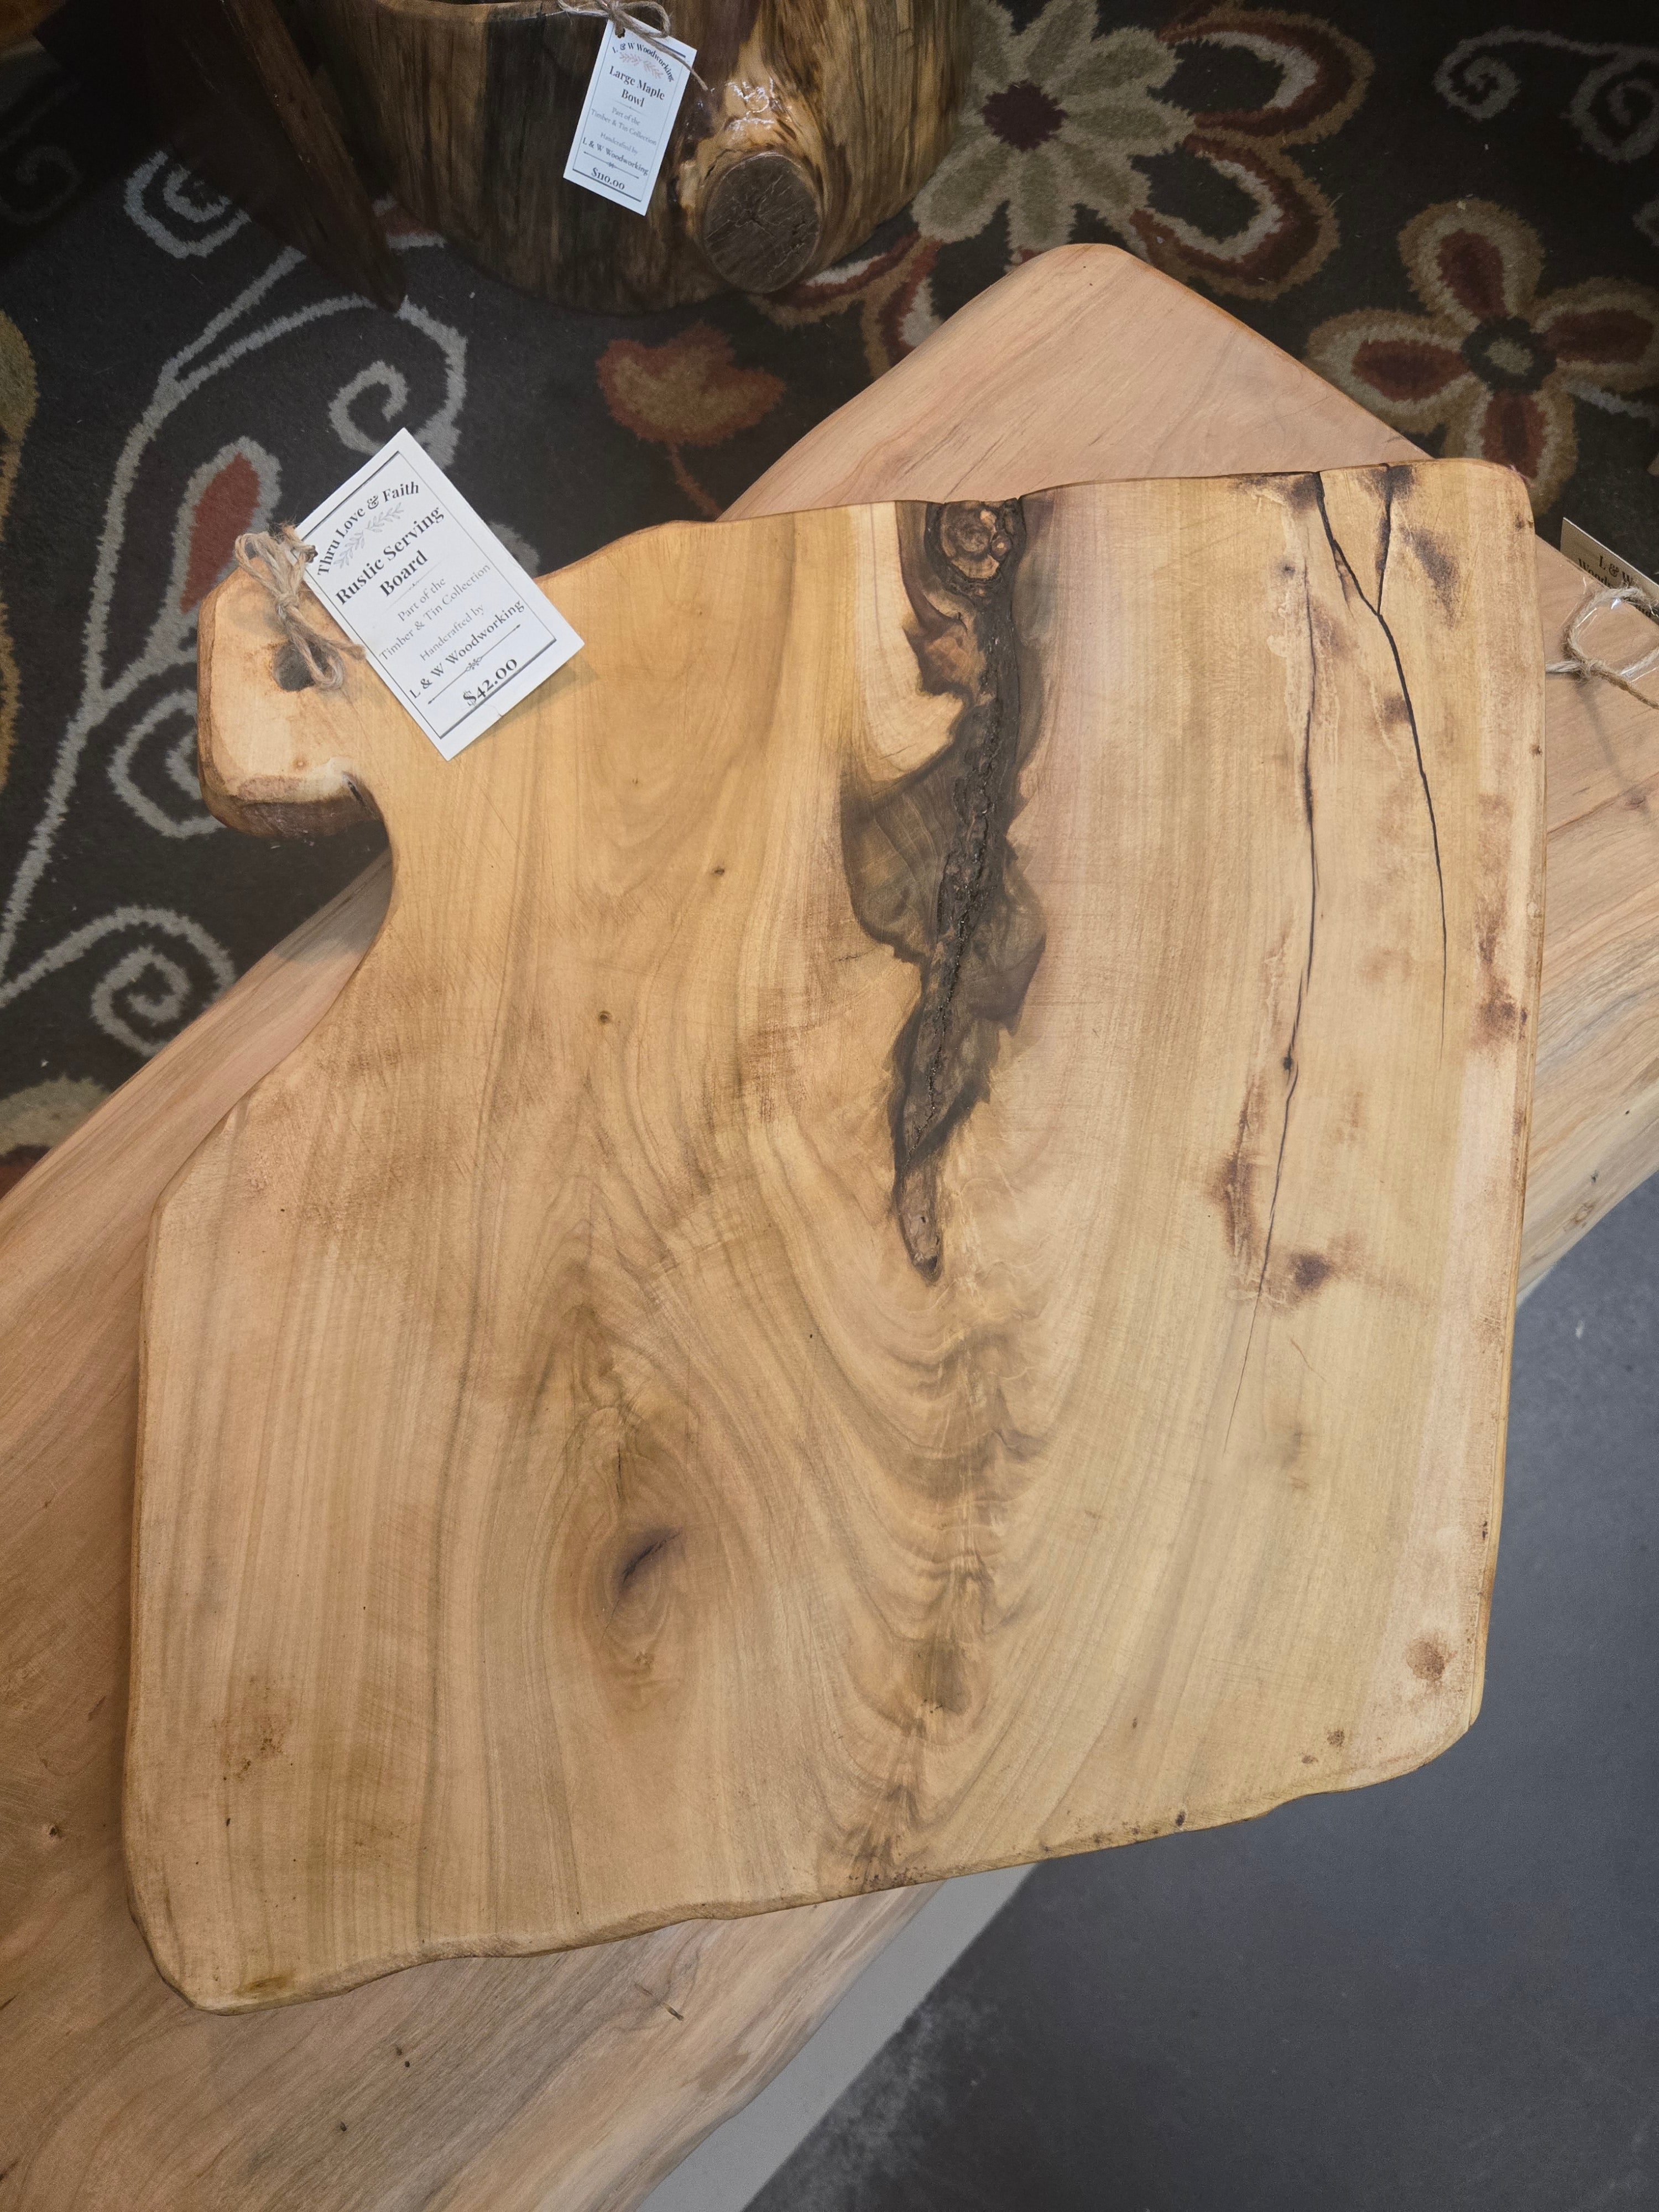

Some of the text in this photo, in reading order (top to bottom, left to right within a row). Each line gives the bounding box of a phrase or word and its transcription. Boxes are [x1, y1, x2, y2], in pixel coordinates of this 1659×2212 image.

[609, 66, 665, 100] Large Maple
[637, 43, 674, 82] Woodworking
[612, 107, 623, 118] Part
[622, 89, 645, 107] Bowl
[591, 108, 611, 123] Timber
[619, 122, 628, 132] Tin
[629, 128, 656, 145] Collection
[591, 167, 625, 190] $110.00
[597, 143, 604, 152] W
[606, 148, 649, 176] Woodworking
[317, 481, 419, 576] Thru Love & Faith
[335, 507, 444, 605] Rustic Serving
[379, 550, 428, 597] Board
[1599, 555, 1606, 570] L
[1609, 564, 1619, 577] &
[379, 565, 491, 660] Timber & Tin Collection
[398, 578, 446, 621] Part of the
[410, 601, 525, 698] L & W Woodworking
[420, 604, 484, 661] Handcrafted by
[463, 659, 517, 707] $42.00
